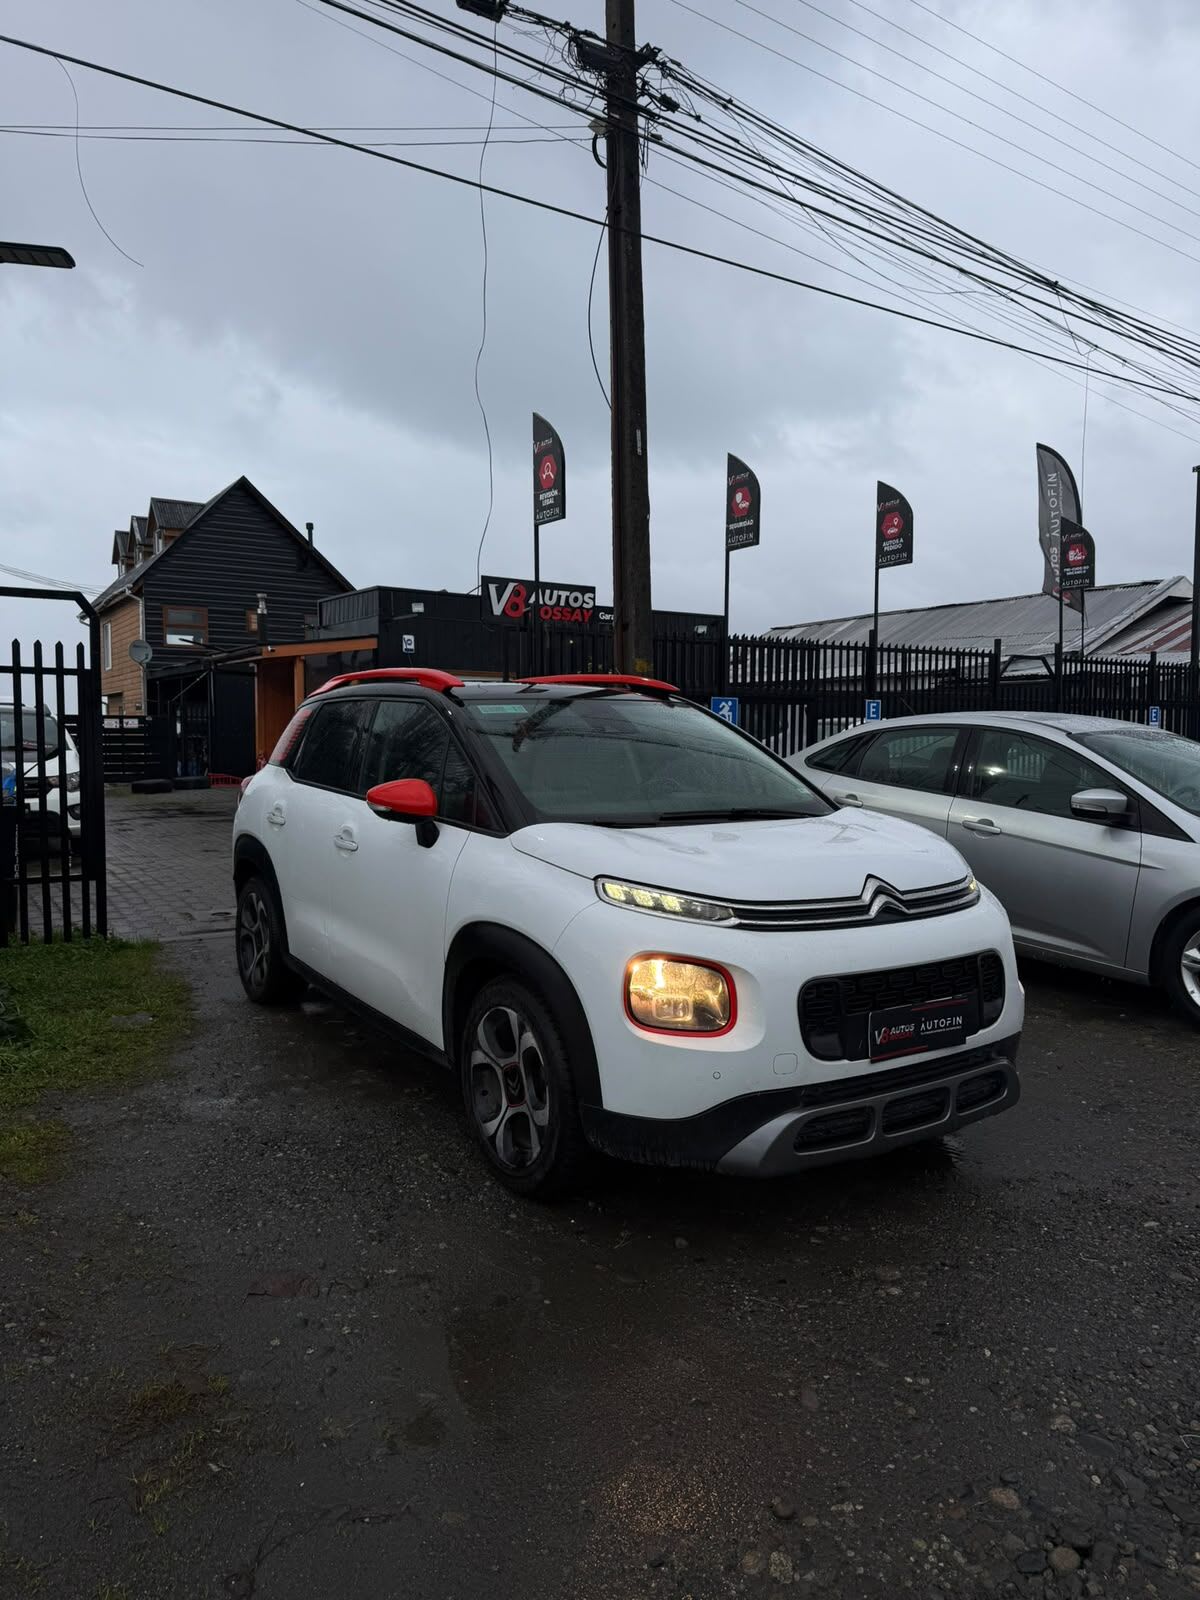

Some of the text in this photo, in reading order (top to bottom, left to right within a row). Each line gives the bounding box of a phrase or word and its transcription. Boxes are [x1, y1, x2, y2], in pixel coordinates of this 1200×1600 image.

[1046, 473, 1060, 537] AUTOFIN
[727, 532, 754, 544] AUTOFIN
[882, 539, 899, 547] AUTOS
[884, 543, 902, 552] PEDIDO
[879, 552, 908, 563] AUTOFIN
[488, 582, 527, 618] V8
[528, 587, 595, 609] AUTOS
[870, 703, 877, 717] E
[1152, 709, 1157, 720] E
[890, 1022, 915, 1034] AUTOS
[920, 1017, 963, 1032] AUTOFIN
